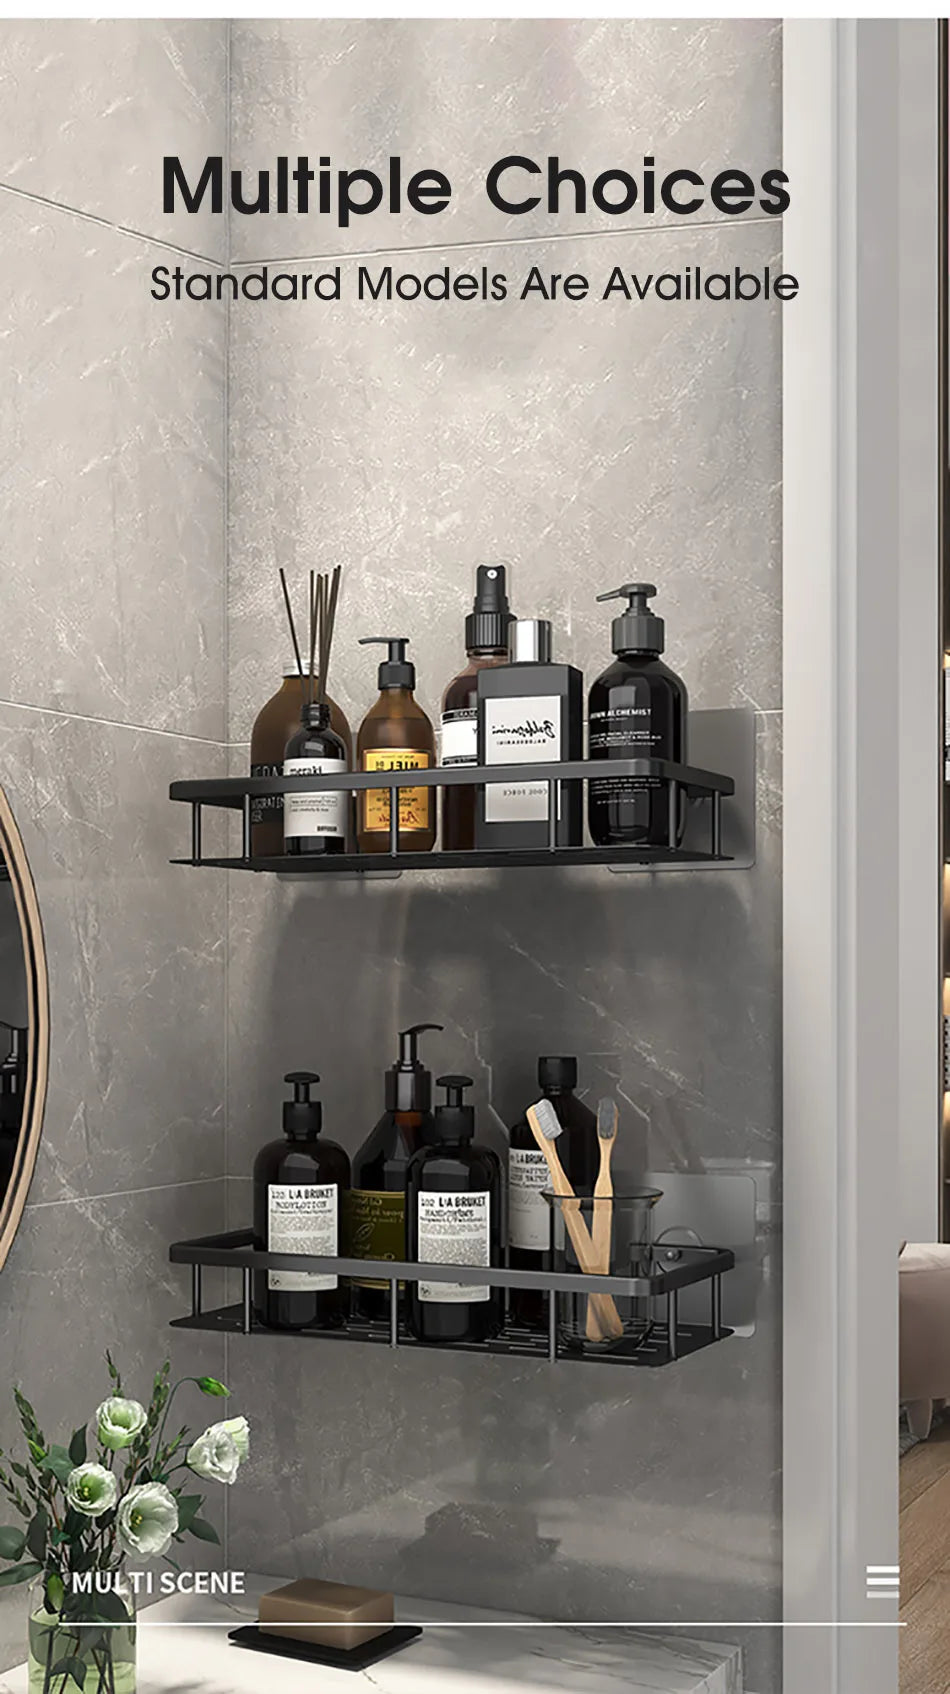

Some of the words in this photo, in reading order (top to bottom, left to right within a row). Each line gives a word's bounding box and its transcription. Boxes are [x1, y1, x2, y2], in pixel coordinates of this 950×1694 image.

[607, 708, 651, 717] ALCHEMIST
[289, 765, 322, 776] meraki
[455, 1195, 486, 1208] BRUKET
